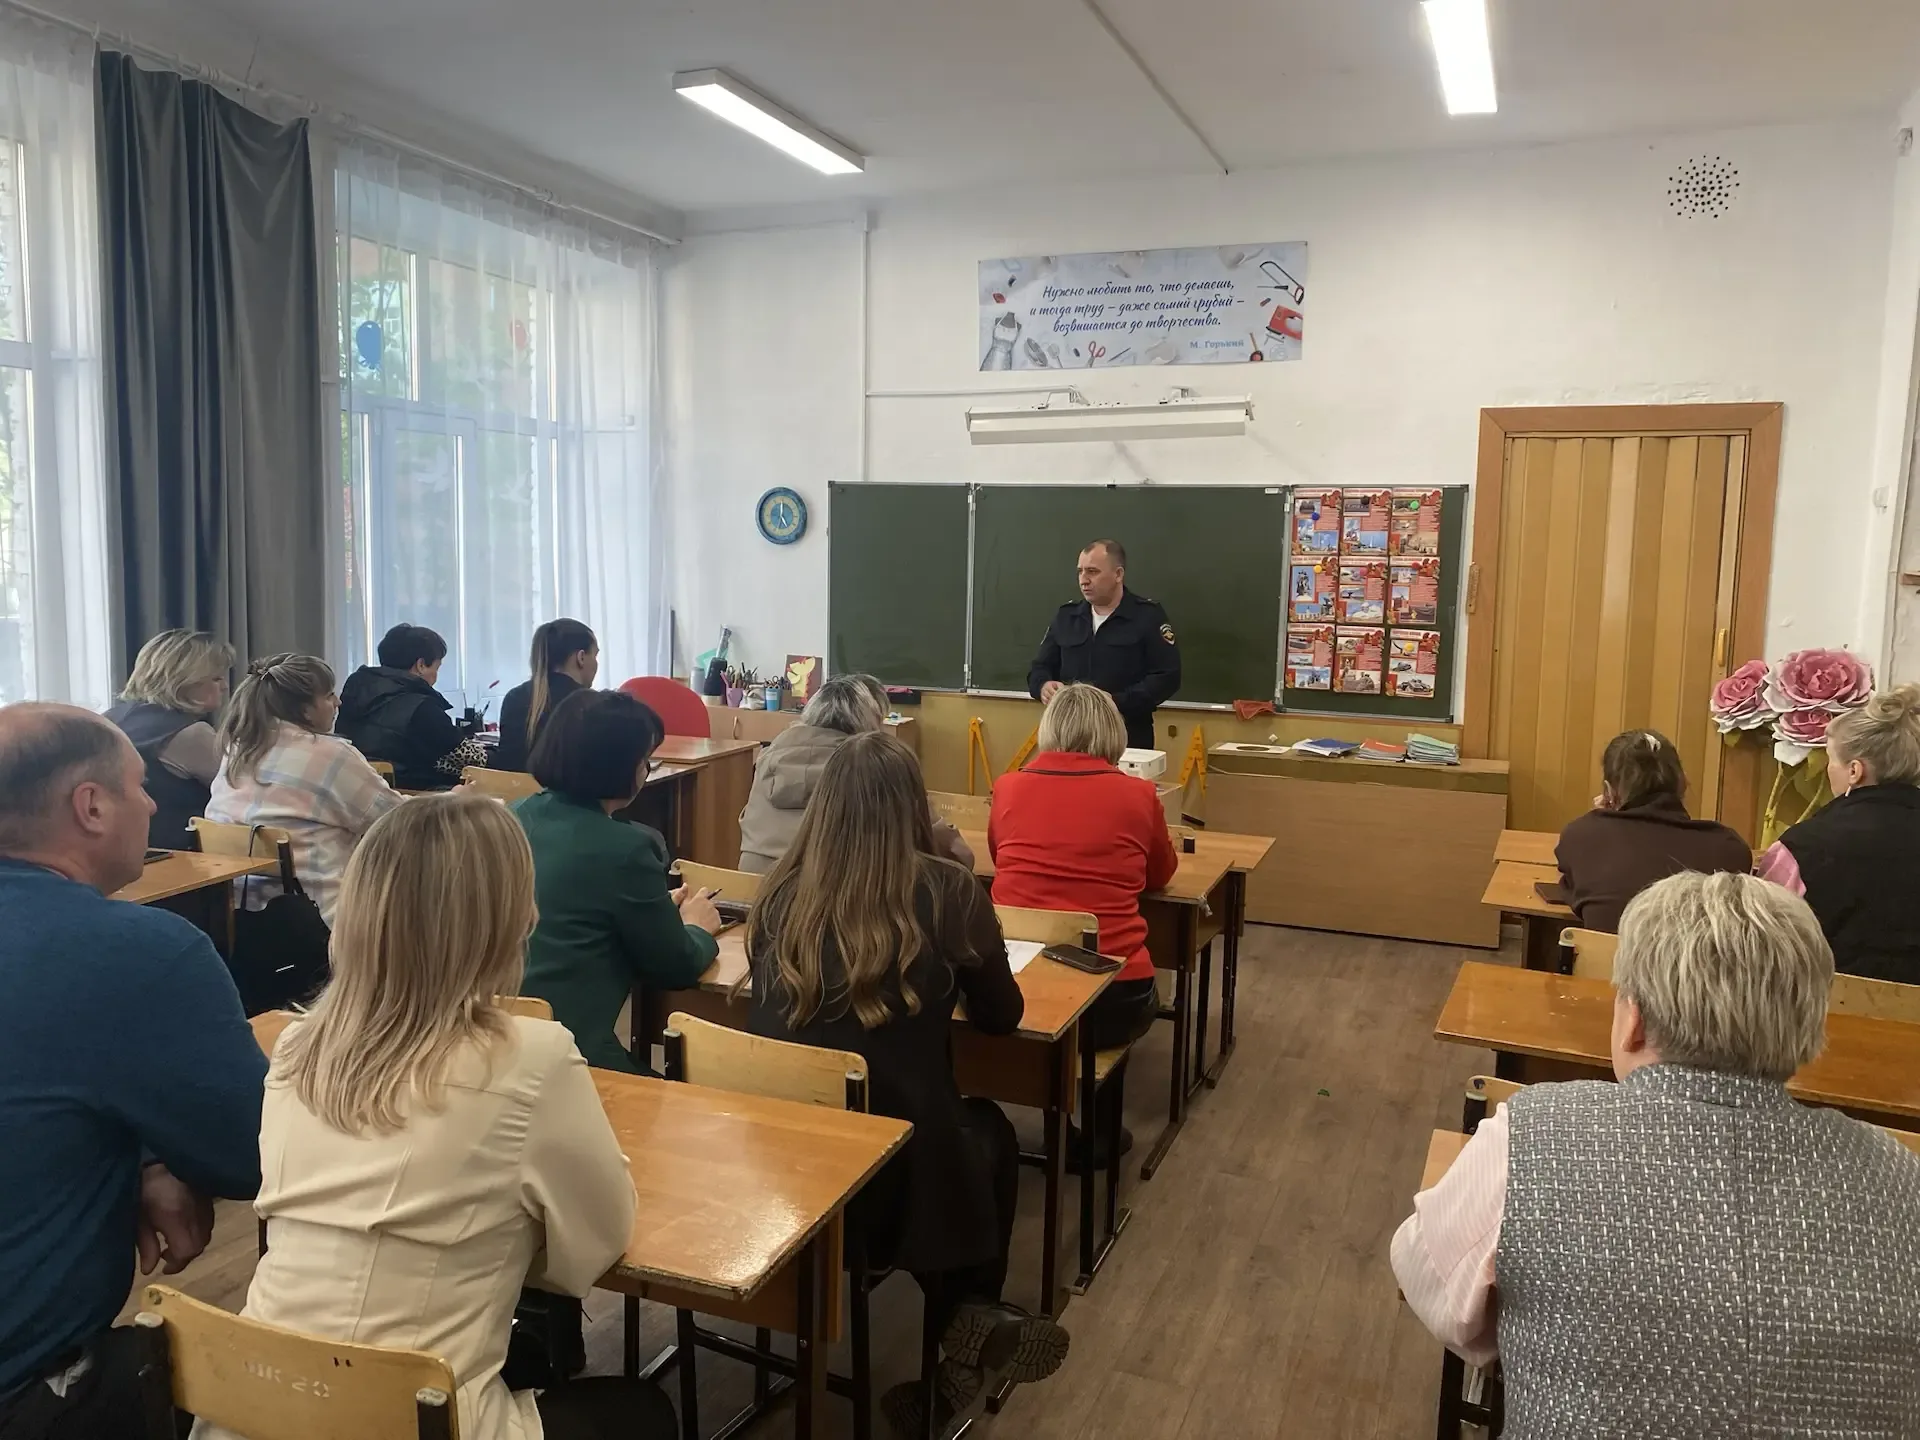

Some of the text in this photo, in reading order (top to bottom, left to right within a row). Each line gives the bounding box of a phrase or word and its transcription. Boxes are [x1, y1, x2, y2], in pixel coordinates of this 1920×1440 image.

[1043, 280, 1234, 302] Нужно любить то, что делаешь,
[1029, 307, 1037, 316] и
[1039, 305, 1072, 319] тогда
[1074, 303, 1105, 318] труд
[1117, 303, 1151, 317] даже
[1128, 320, 1143, 335] до
[1146, 312, 1221, 332] творчества.
[1190, 339, 1244, 349] М. Горький
